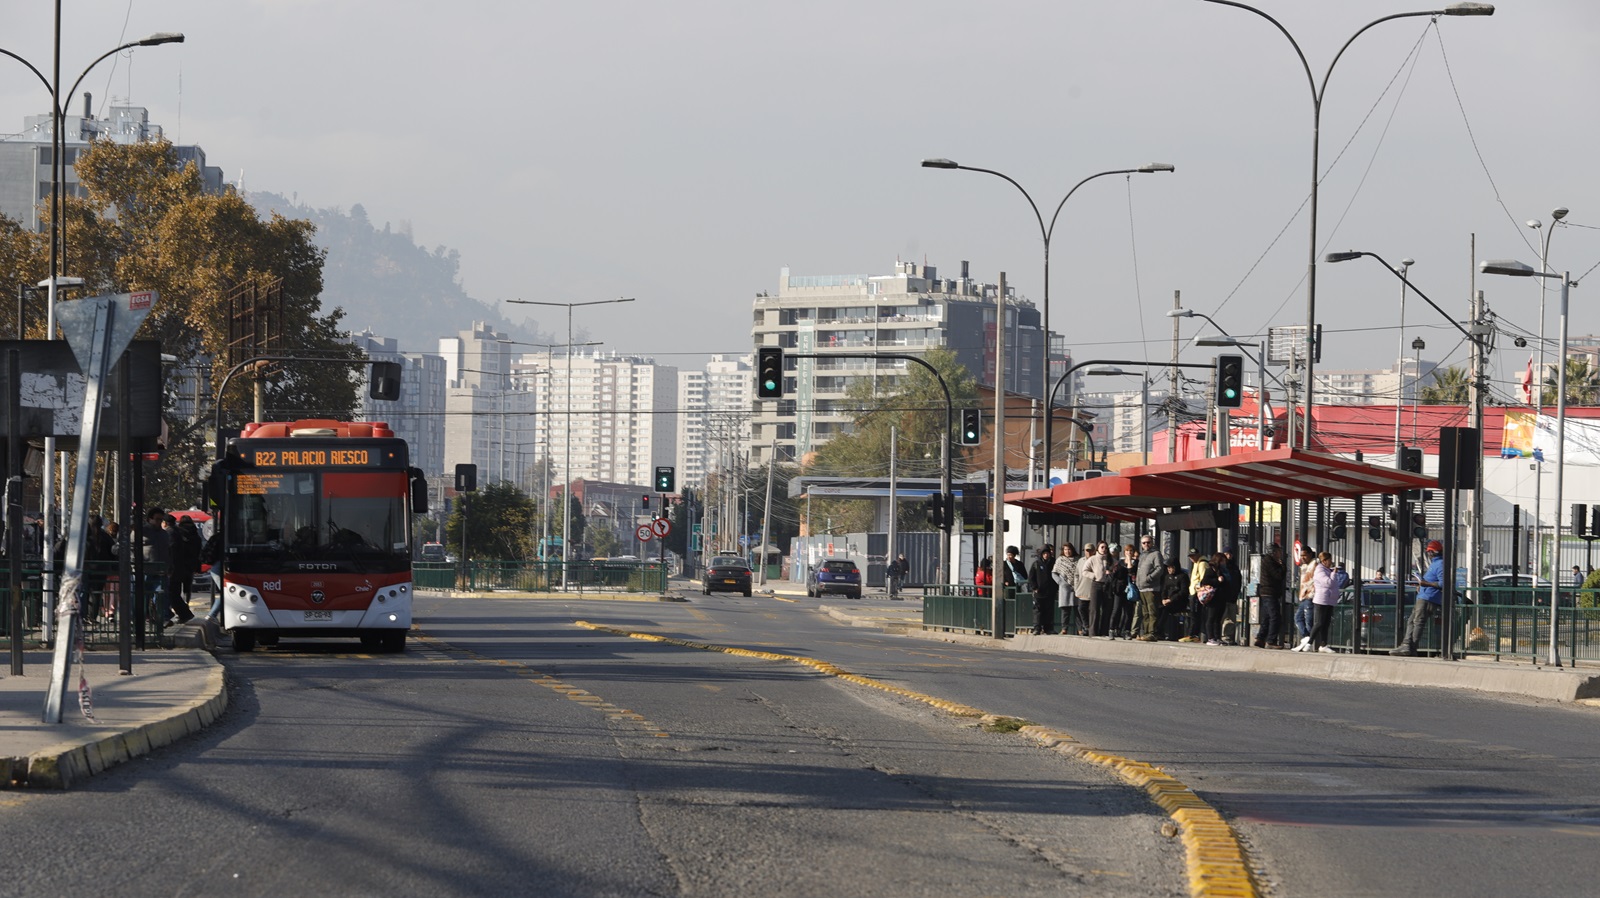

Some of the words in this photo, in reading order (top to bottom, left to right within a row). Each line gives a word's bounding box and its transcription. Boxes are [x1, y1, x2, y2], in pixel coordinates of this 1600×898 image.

[132, 295, 149, 303] EGSA
[255, 451, 277, 466] B22
[281, 451, 326, 465] PALACIO
[330, 450, 368, 465] RIESCO
[640, 529, 651, 537] 50
[263, 579, 282, 591] Red
